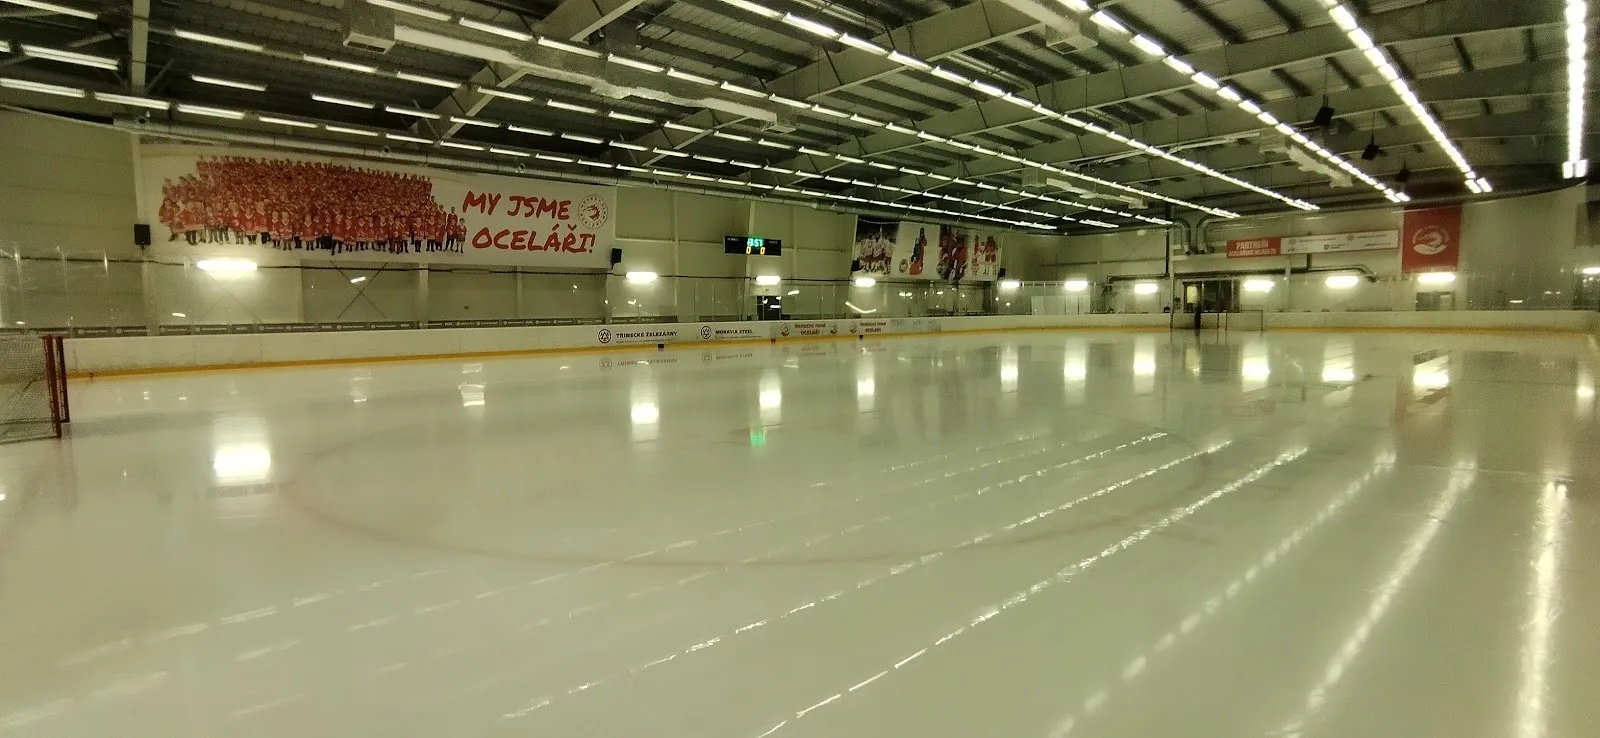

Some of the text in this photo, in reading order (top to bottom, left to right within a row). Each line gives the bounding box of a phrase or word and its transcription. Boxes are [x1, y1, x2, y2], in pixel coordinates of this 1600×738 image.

[462, 190, 572, 220] MY JSME
[471, 223, 596, 254] OCELÁŘI!
[746, 246, 766, 255] 0 0
